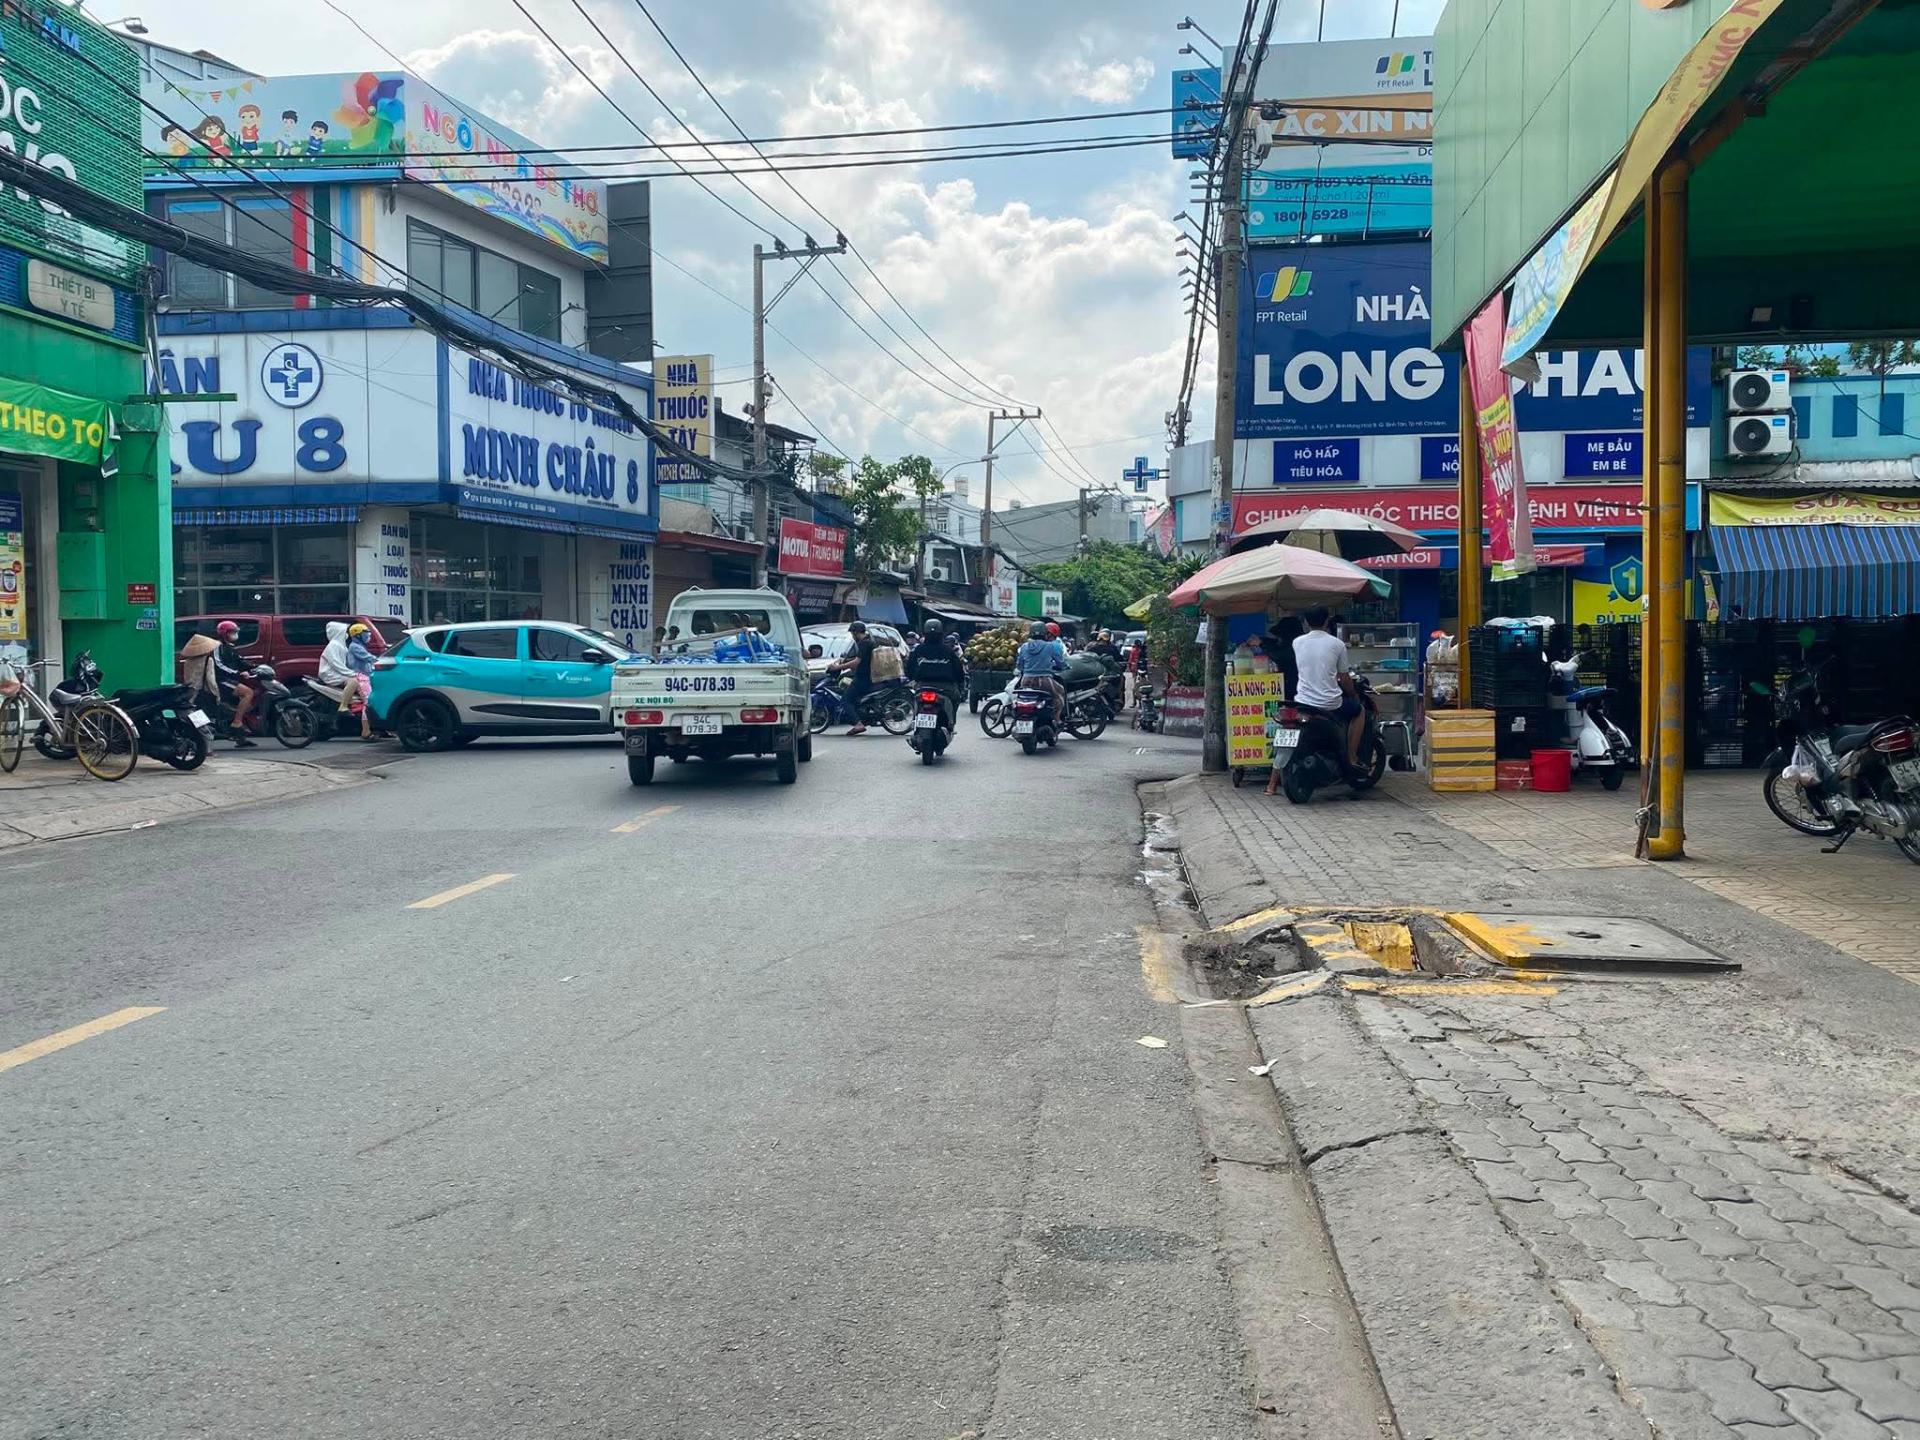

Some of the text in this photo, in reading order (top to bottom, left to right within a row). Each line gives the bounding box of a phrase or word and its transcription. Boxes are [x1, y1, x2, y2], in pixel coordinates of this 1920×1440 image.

[1377, 79, 1414, 88] FPT Retail
[423, 101, 480, 152] NGÔI
[1336, 111, 1393, 134] XIN
[1404, 111, 1433, 132] N
[1273, 208, 1348, 222] 1800 6928
[61, 298, 67, 313] Y
[1357, 285, 1430, 322] NHÀ
[1256, 310, 1307, 323] FPT Retail
[667, 359, 698, 387] NHÀ
[1254, 347, 1445, 406] LONG
[657, 388, 709, 420] THUỐC
[0, 403, 66, 440] THEO
[171, 416, 347, 475] U 8
[668, 425, 698, 451] TÂY
[1587, 437, 1632, 455] MẸ BẦU
[1294, 445, 1340, 460] HÔ HẤP
[1443, 444, 1459, 454] DA
[462, 422, 639, 505] MINH CHÂU 8
[1290, 465, 1343, 477] TIÊU HÓA
[1592, 460, 1610, 471] EM
[657, 463, 678, 481] MINH
[1408, 504, 1459, 521] THEO
[1574, 498, 1619, 521] VIỆN
[1751, 514, 1837, 525] CHUYÊN
[387, 544, 405, 560] LOẠI
[782, 536, 809, 558] MOTUL
[1405, 552, 1432, 564] NƠI
[382, 562, 408, 578] THUỐC
[387, 583, 406, 597] THEO
[611, 583, 649, 605] MINH
[388, 603, 404, 616] TOA
[610, 603, 649, 629] CHÂU
[665, 676, 736, 692] 94C-078.39
[693, 714, 711, 724] 94C
[686, 724, 718, 734] 078.39
